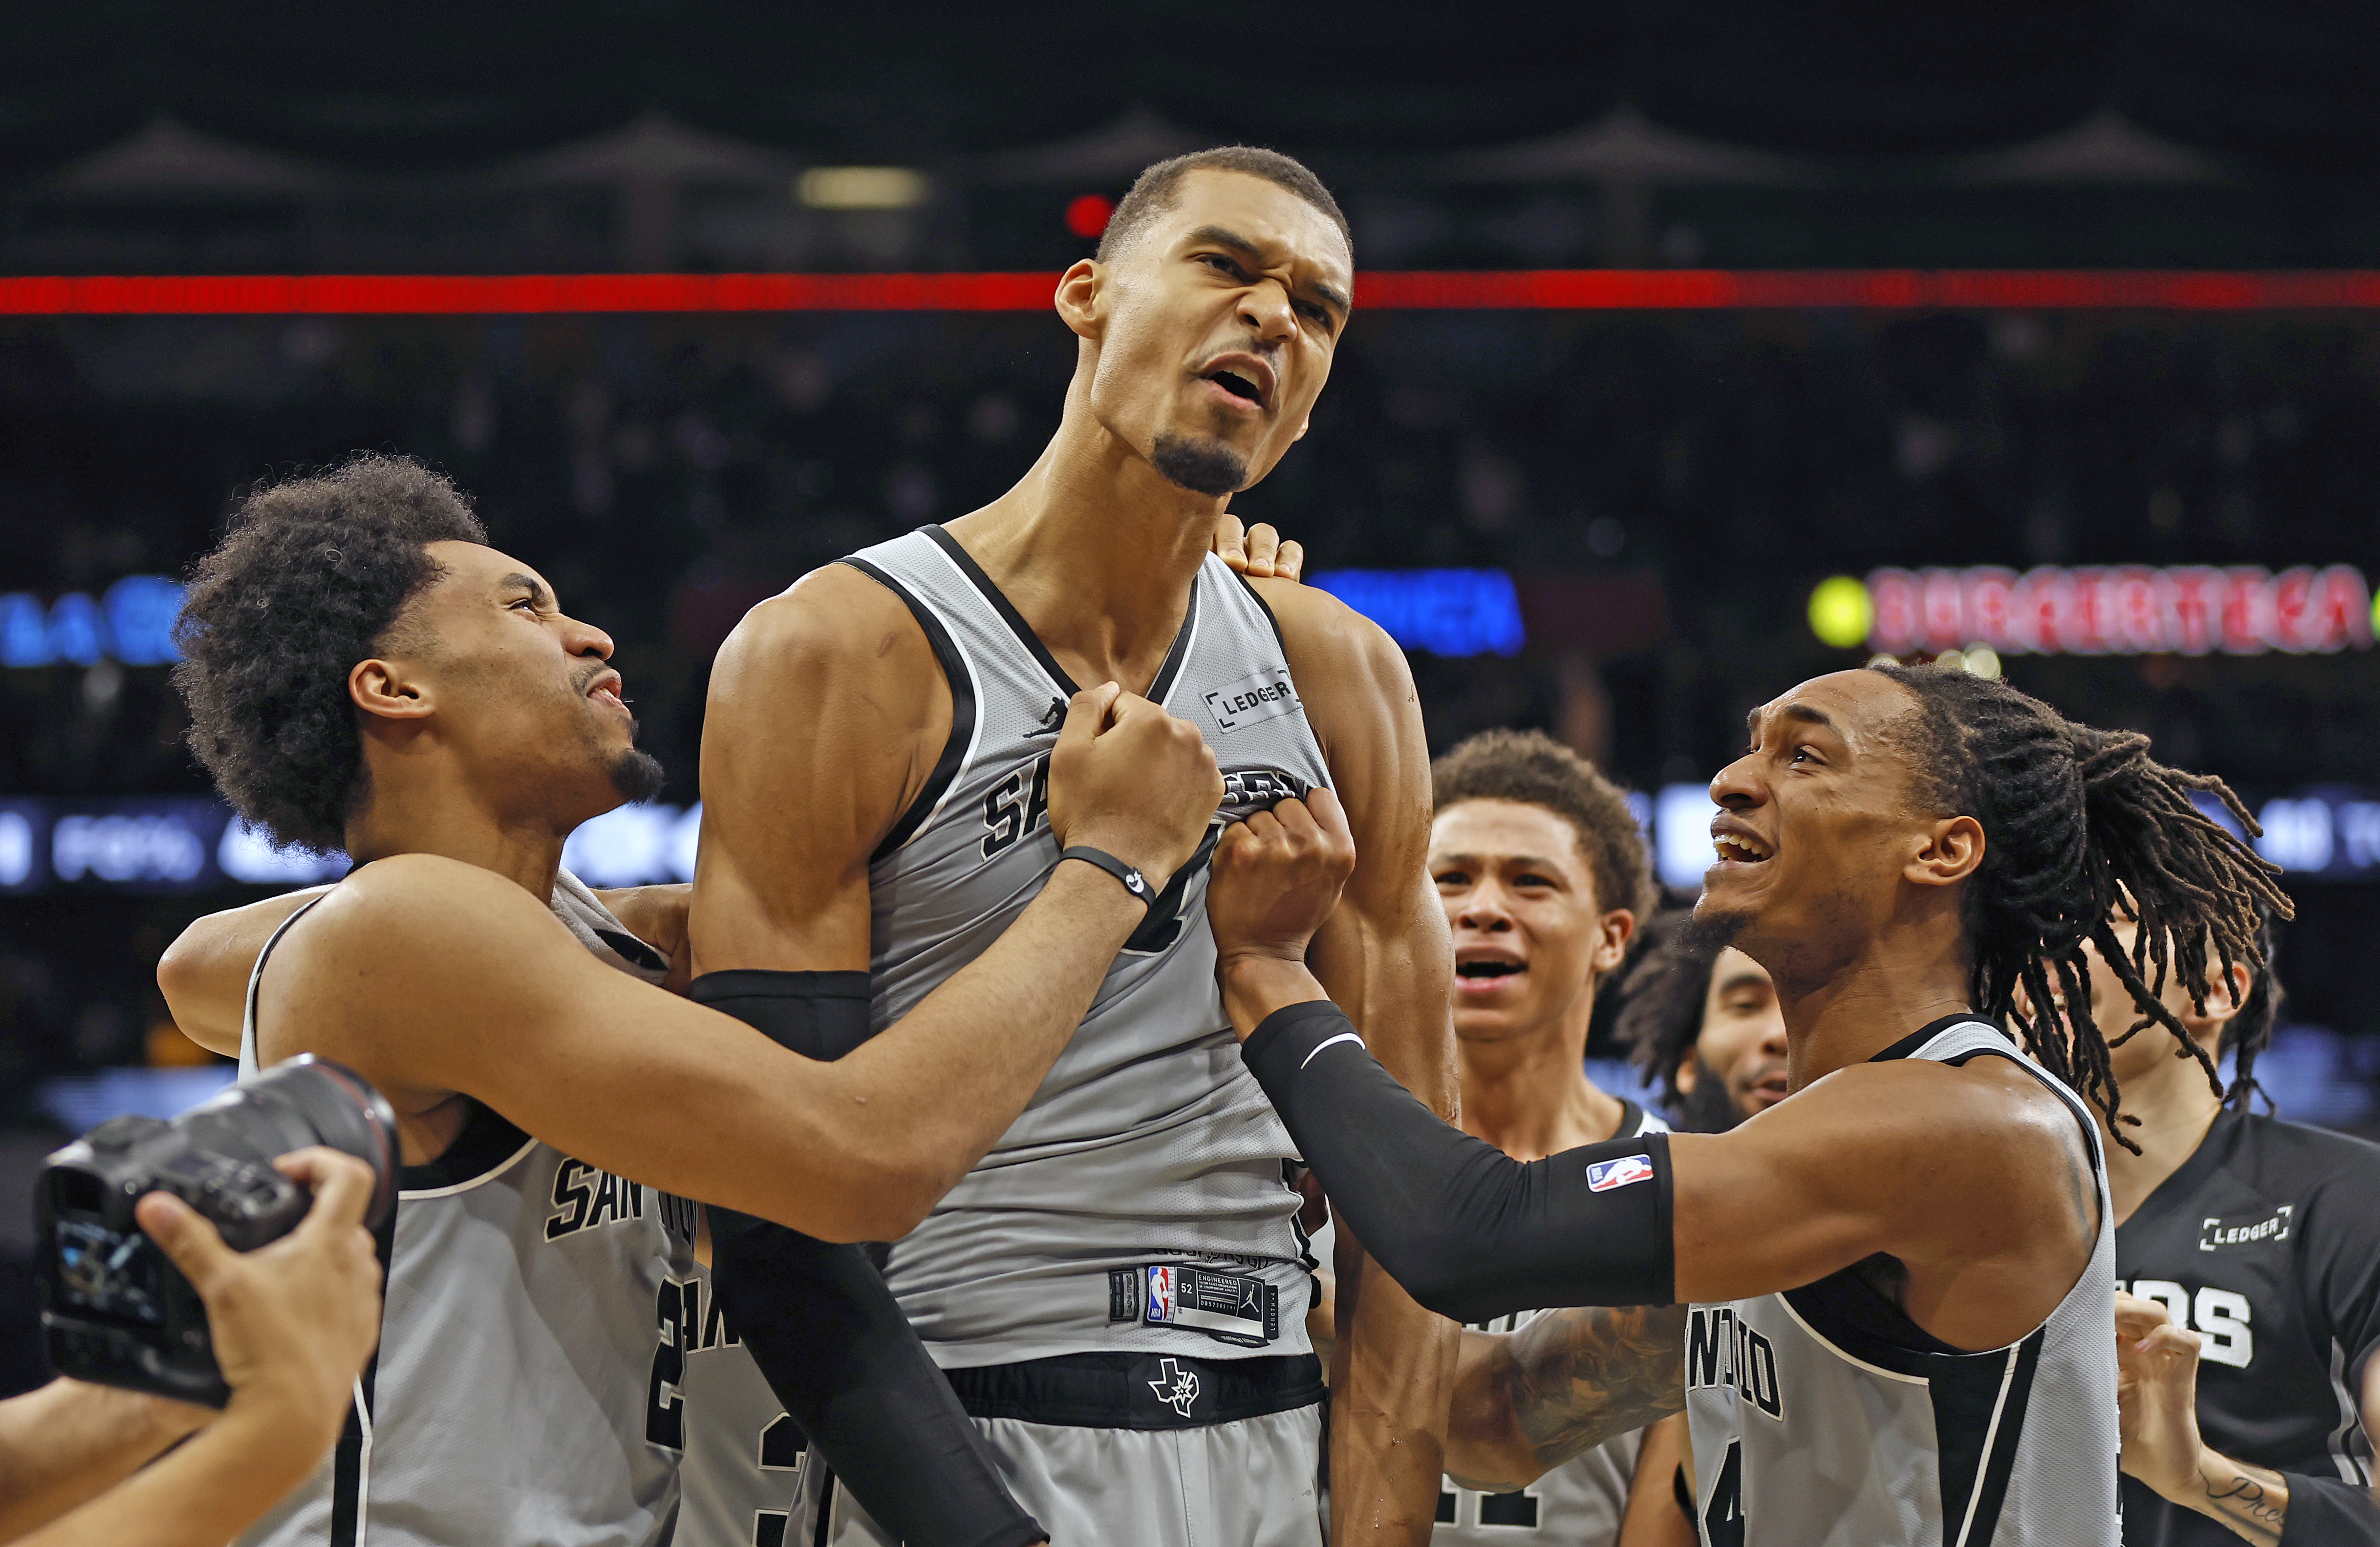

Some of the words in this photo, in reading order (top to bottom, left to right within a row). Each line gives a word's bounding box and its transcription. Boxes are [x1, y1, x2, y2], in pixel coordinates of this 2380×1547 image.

[1222, 681, 1291, 715] LEDGER
[980, 750, 1051, 862] SA
[2214, 1217, 2280, 1244] LEDGER
[1181, 1282, 1192, 1294] 52
[1198, 1274, 1237, 1286] ENGINEERED
[1150, 1307, 1161, 1318] NBA
